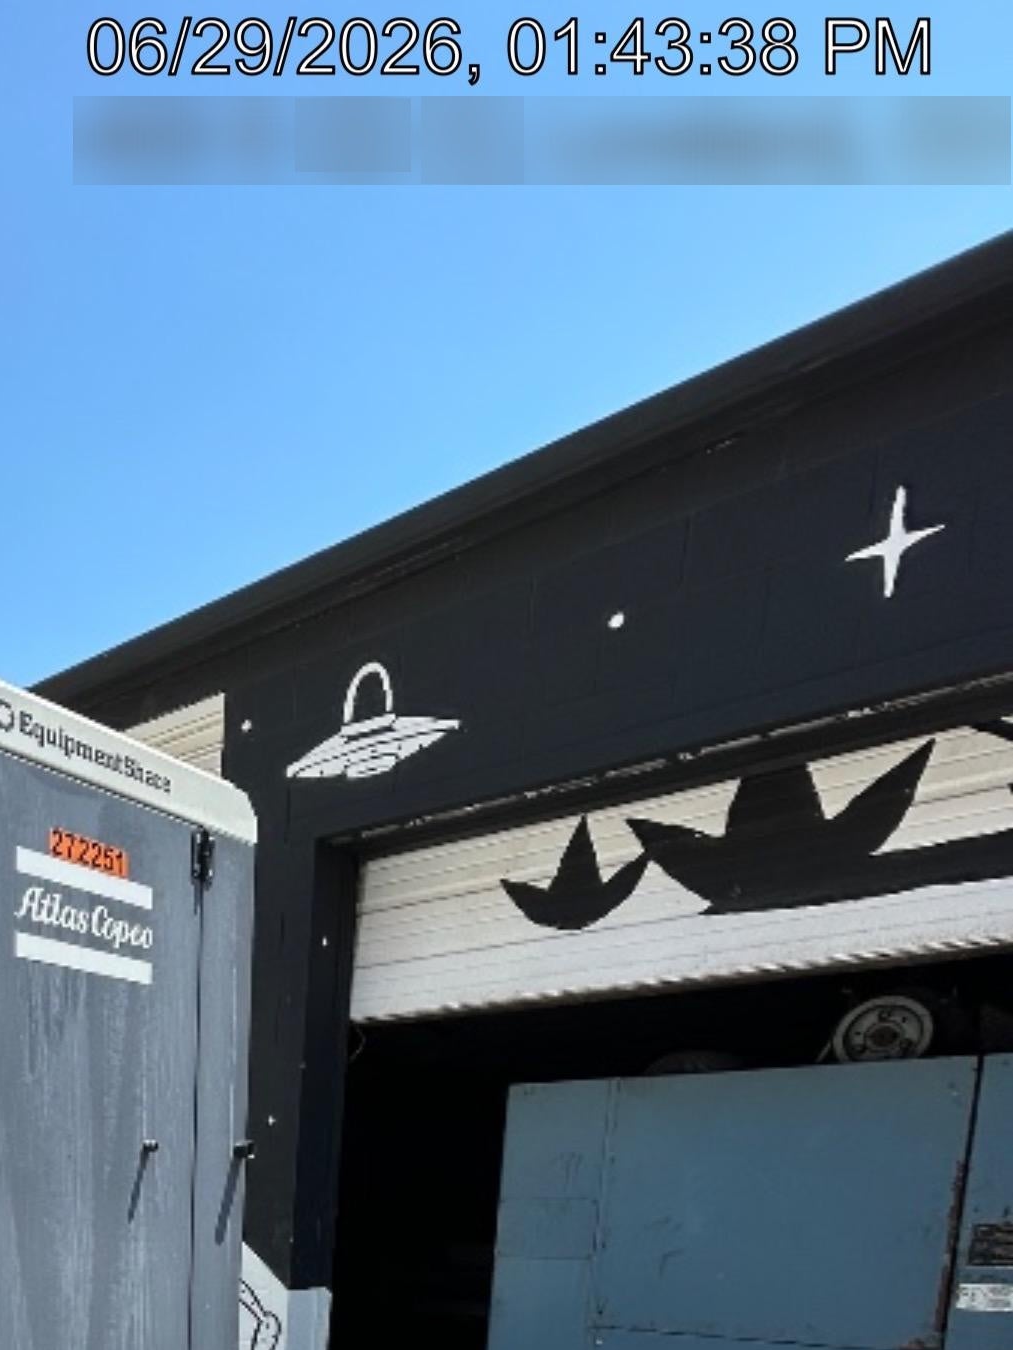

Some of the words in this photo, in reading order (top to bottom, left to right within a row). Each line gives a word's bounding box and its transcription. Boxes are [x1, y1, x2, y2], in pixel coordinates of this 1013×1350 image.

[52, 829, 123, 876] 272251
[14, 887, 89, 933] Atlas
[91, 905, 153, 949] Copco
